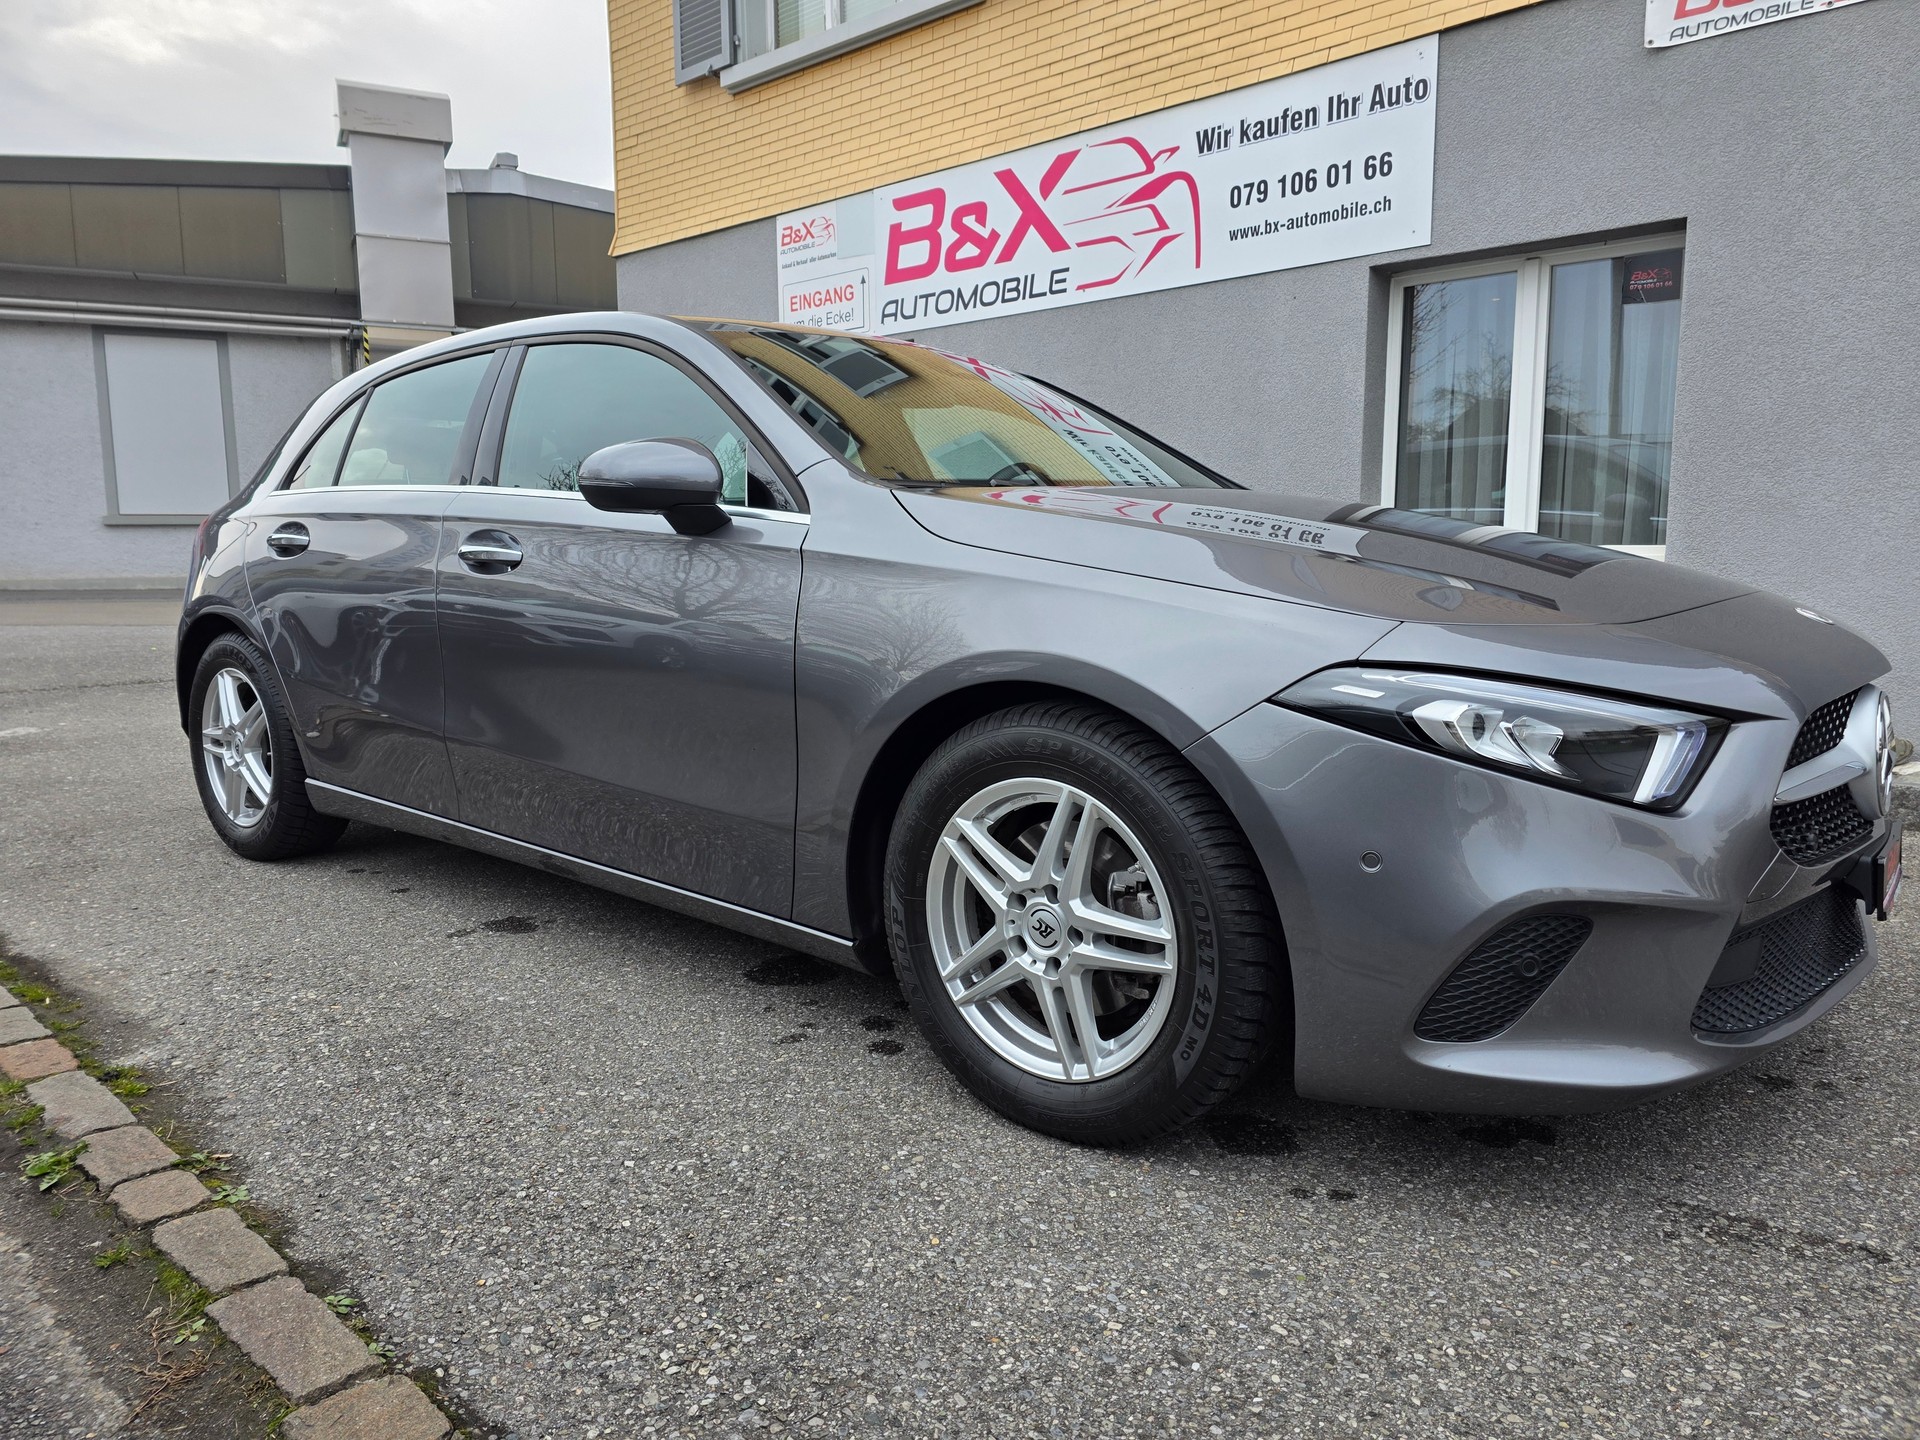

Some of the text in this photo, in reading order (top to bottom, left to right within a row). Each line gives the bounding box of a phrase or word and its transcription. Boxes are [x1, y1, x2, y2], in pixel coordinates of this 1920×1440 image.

[1669, 0, 1814, 41] AUTOMOBILE
[1196, 75, 1429, 155] Wir kaufen Ihr Auto
[1229, 151, 1393, 209] 079 106 01 66
[780, 218, 817, 247] B&X
[884, 148, 1082, 286] B&X
[1229, 195, 1392, 242] www.bx-automobile.ch
[780, 241, 816, 255] AUTOMOBILE
[790, 284, 855, 313] EINGANG
[808, 314, 823, 327] die
[826, 307, 854, 326] Ecke!
[881, 266, 1071, 325] AUTOMOBILE
[1024, 736, 1063, 754] SP
[1067, 746, 1177, 843] WINTER
[1169, 851, 1216, 977] SPORT
[891, 905, 952, 1049] DUNLOP
[1191, 983, 1213, 1032] 4D
[1181, 1035, 1200, 1061] MO
